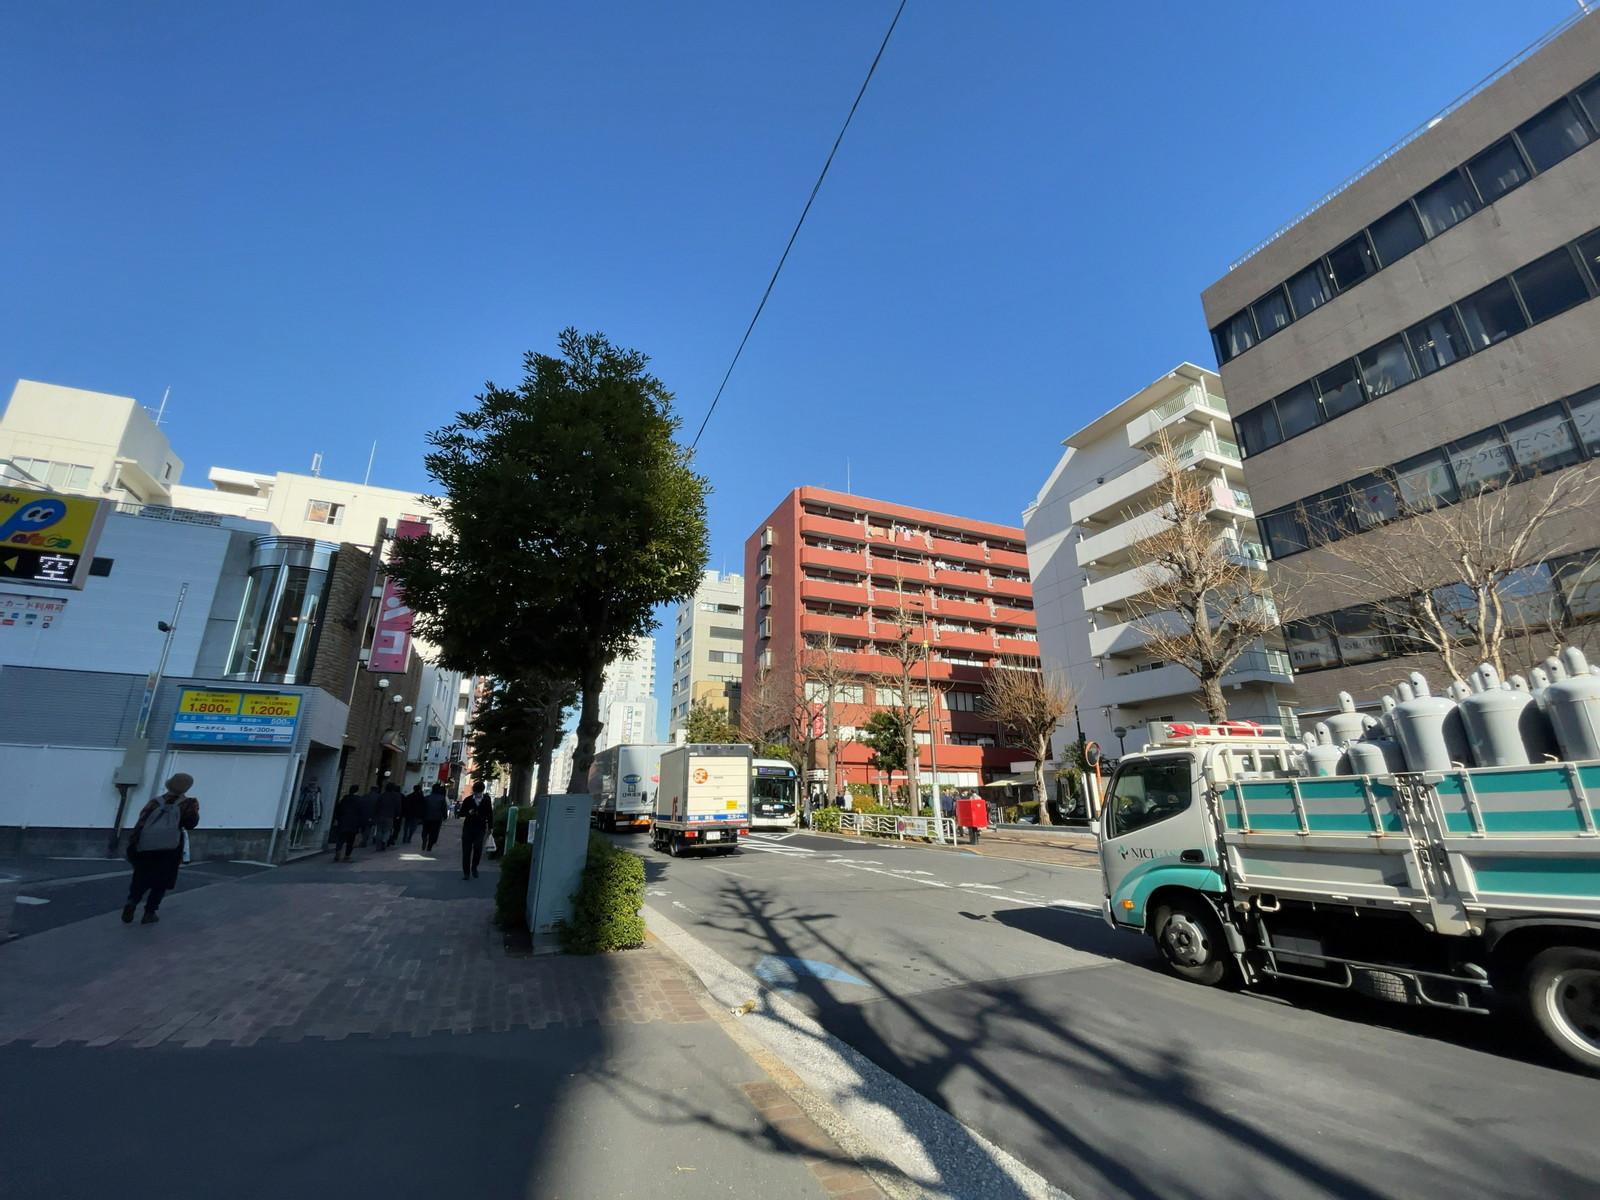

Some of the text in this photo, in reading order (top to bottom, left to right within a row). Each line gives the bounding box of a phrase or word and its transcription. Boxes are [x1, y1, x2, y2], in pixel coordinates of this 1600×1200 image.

[34, 554, 74, 582] 空
[189, 703, 231, 714] 1,800円
[250, 705, 290, 716] 1,200円
